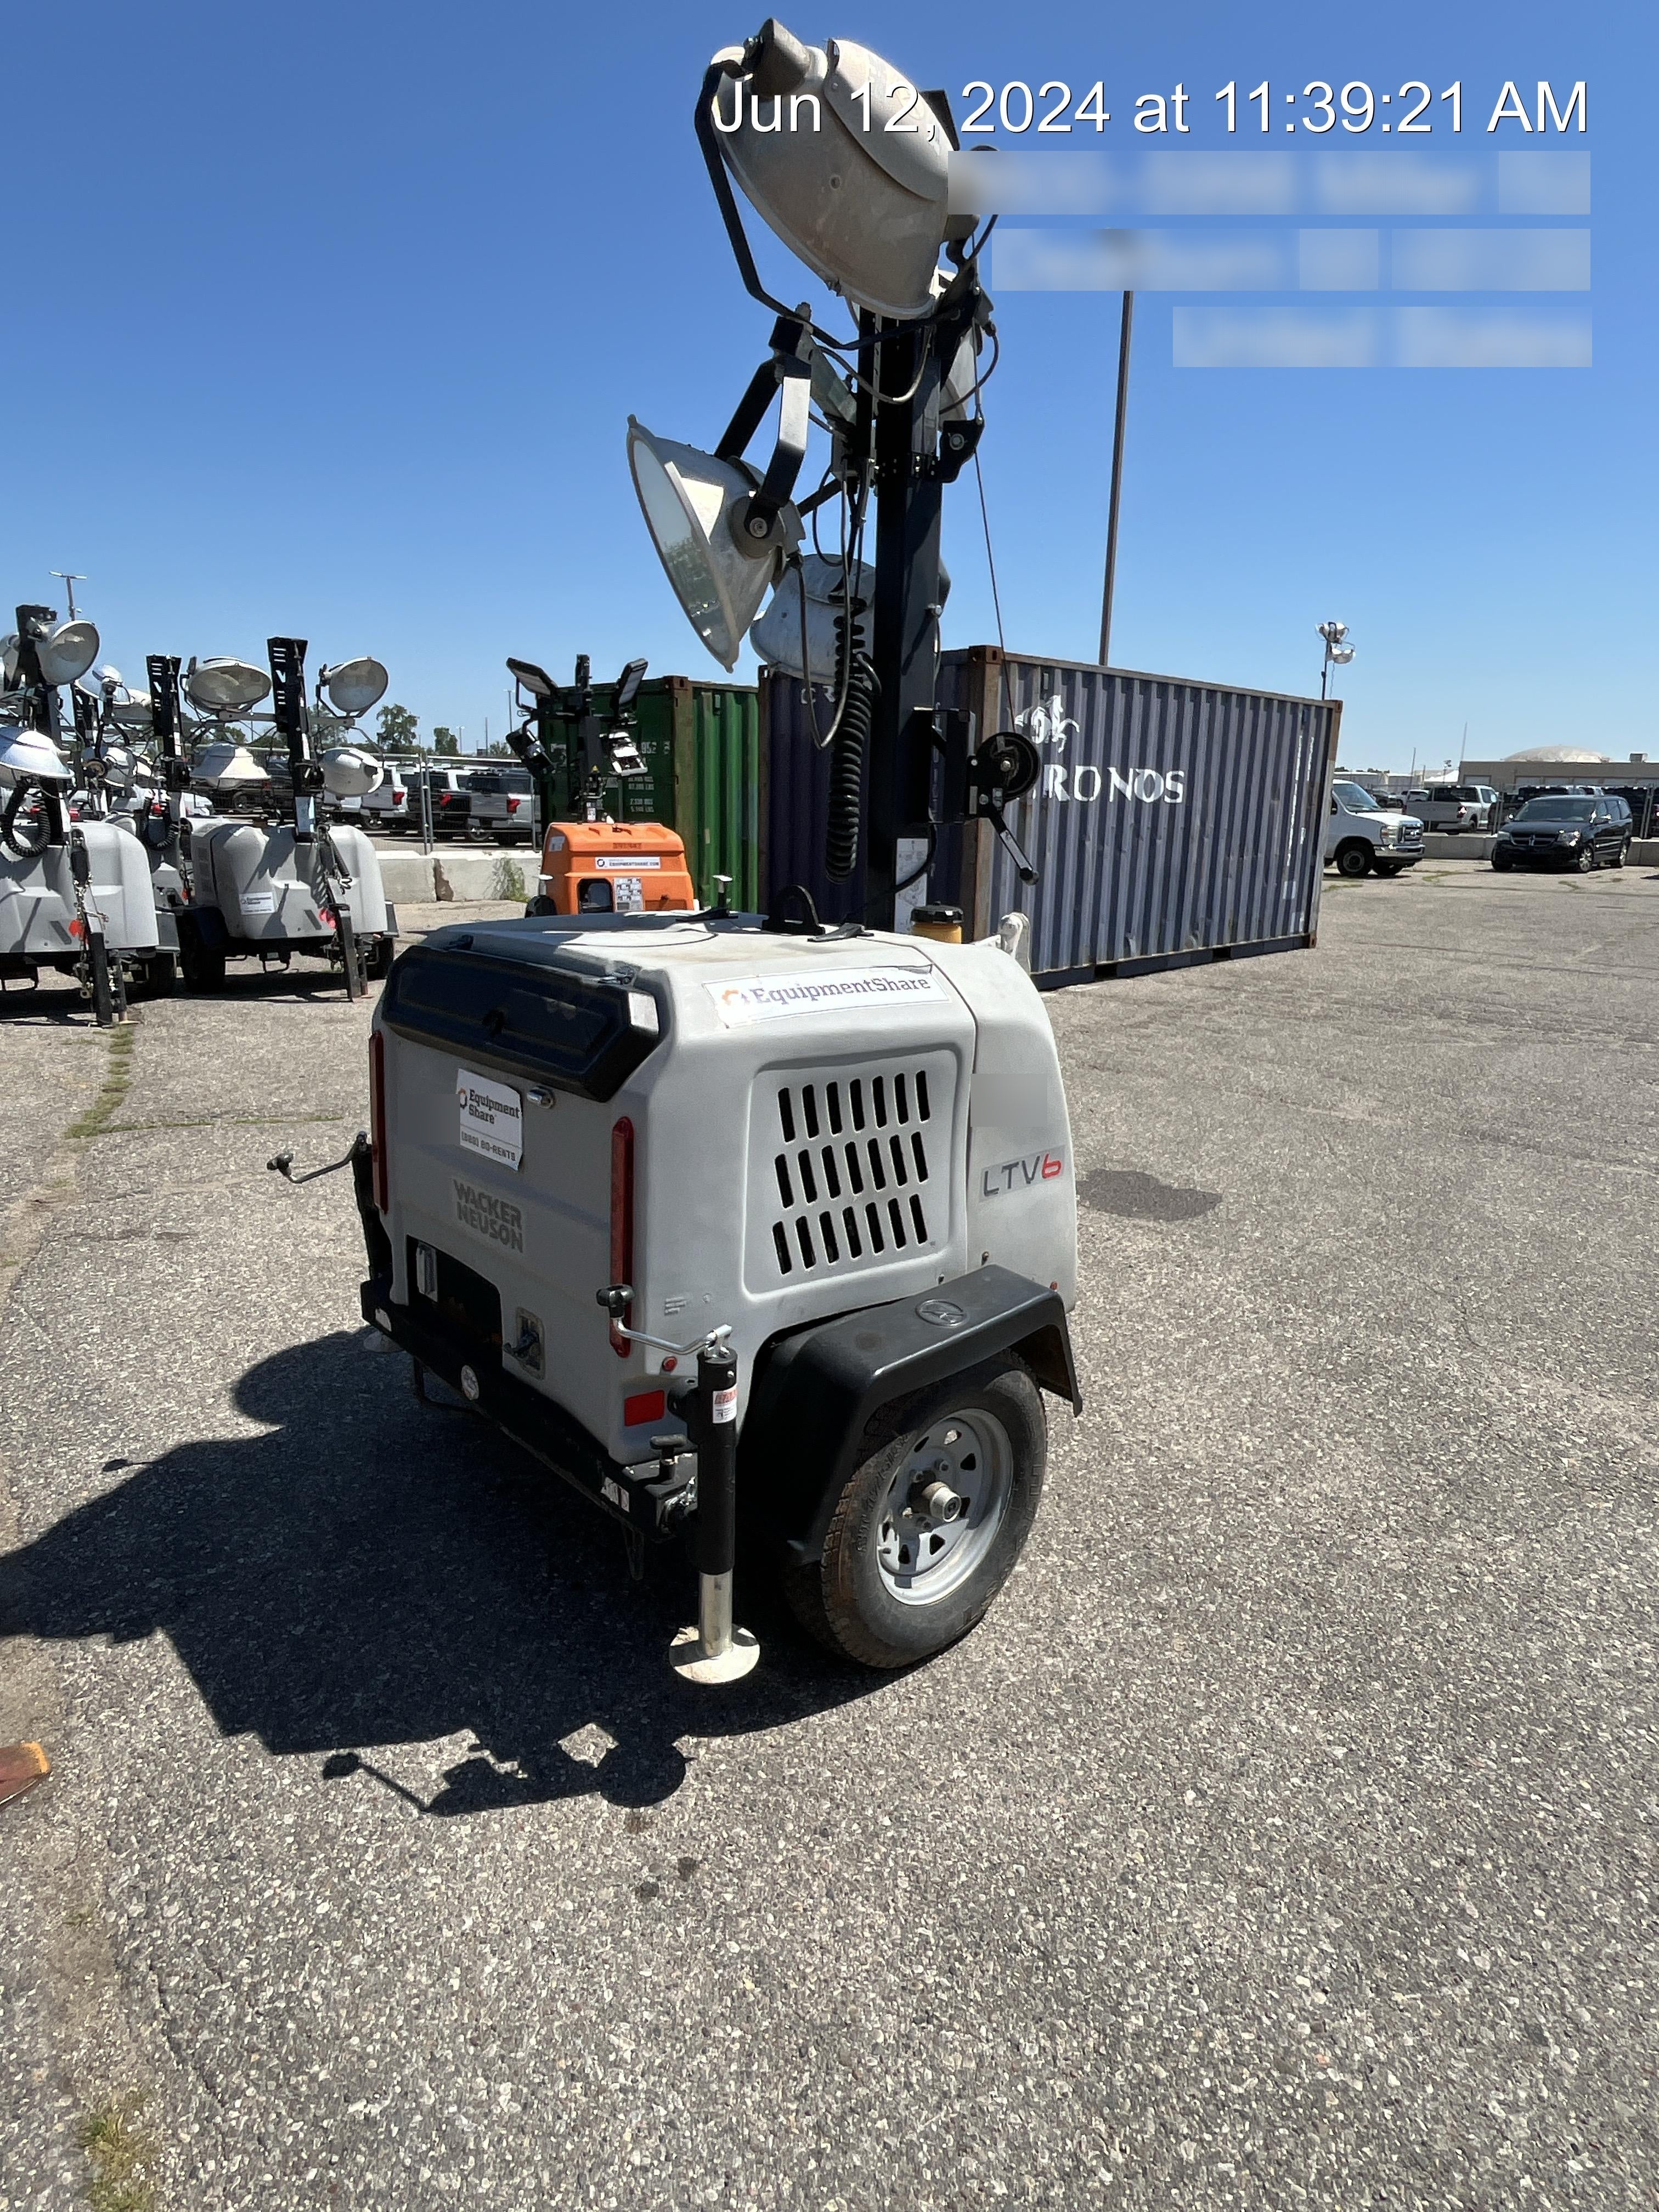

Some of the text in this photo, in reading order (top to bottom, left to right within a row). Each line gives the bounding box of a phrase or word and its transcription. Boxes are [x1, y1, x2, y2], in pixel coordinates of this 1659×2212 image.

[1031, 764, 1185, 803] RONOS
[749, 977, 931, 1005] EquipmentShare
[469, 1088, 520, 1119] Equipment
[469, 1104, 495, 1125] Share
[984, 1153, 1062, 1197] LTV6
[453, 1180, 522, 1231] WACKER
[456, 1200, 523, 1254] NEUSON
